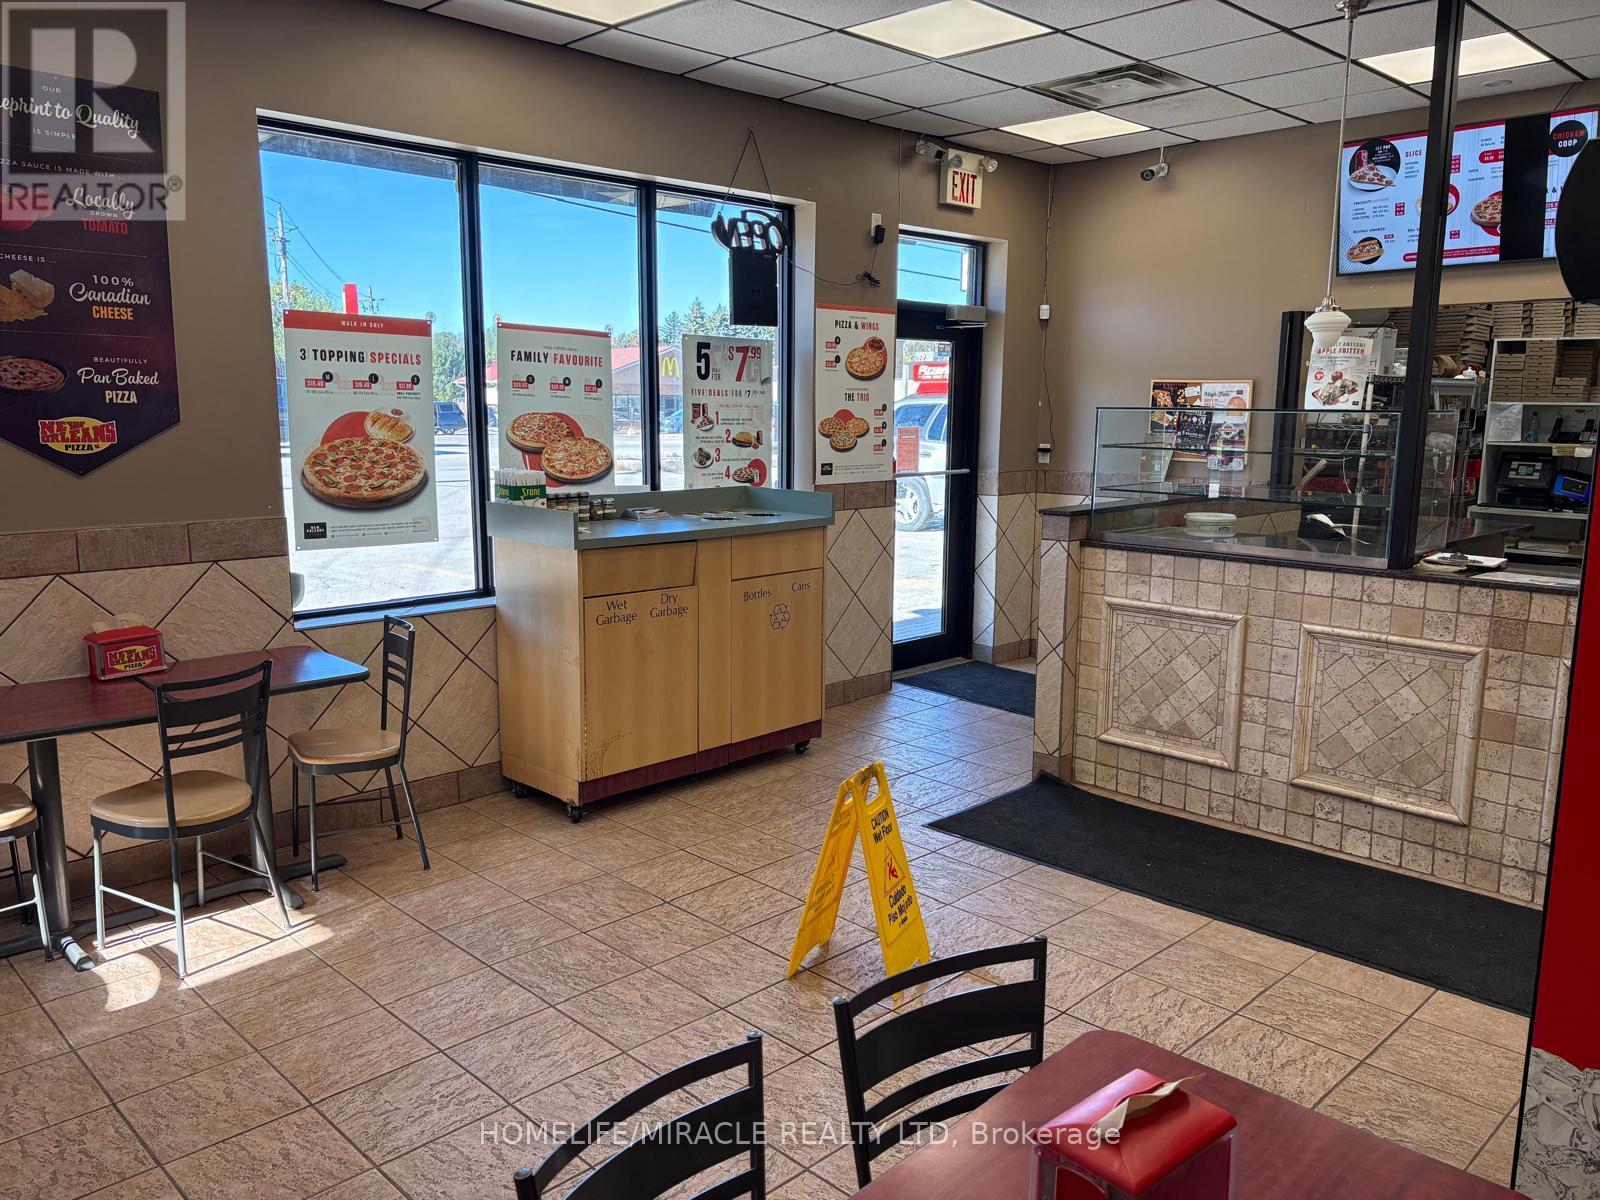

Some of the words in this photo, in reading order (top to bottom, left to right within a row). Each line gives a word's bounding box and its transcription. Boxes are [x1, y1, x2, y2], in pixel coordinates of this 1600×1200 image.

[42, 85, 61, 93] OUR
[0, 97, 52, 118] eprint
[55, 102, 73, 119] to
[75, 104, 140, 139] Quality
[45, 129, 77, 140] SIMPLE
[1553, 129, 1585, 140] CHICKEN
[1558, 139, 1577, 148] COOP
[21, 161, 51, 170] SAUCE
[66, 167, 91, 175] MADE
[952, 170, 977, 205] EXIT
[65, 187, 135, 220] Locally
[90, 210, 118, 218] GROWN
[82, 218, 129, 235] TOMATO
[92, 274, 134, 287] 100%
[69, 282, 151, 305] Canadian
[92, 305, 134, 320] CHEESE
[369, 321, 384, 329] ONLY
[834, 320, 851, 329] PIZZA
[854, 321, 858, 330] &
[861, 321, 879, 331] WINGS
[300, 348, 306, 361] 3
[312, 349, 365, 363] TOPPING
[370, 351, 422, 366] SPECIALS
[1339, 347, 1365, 355] FRITTER
[93, 356, 148, 365] BEAUTIFULLY
[510, 350, 549, 363] FAMILY
[553, 353, 603, 368] FAVOURITE
[697, 342, 711, 380] 5
[77, 367, 111, 385] Pan
[111, 368, 160, 386] Baked
[105, 390, 137, 404] PIZZA
[691, 388, 705, 396] FIVE
[709, 389, 728, 397] DEALS
[844, 392, 854, 402] THE
[857, 392, 870, 402] TRIO
[40, 421, 85, 433] NEW
[41, 423, 117, 443] ORLEANS
[725, 429, 731, 443] 2
[715, 448, 720, 462] 3
[725, 465, 730, 479] 4
[791, 581, 811, 593] Cans
[660, 592, 678, 605] Dry
[743, 588, 772, 602] Bottles
[606, 600, 628, 611] Wet
[650, 605, 689, 619] Garbage
[595, 612, 638, 626] Garbage
[871, 808, 889, 830] CAUTION
[873, 829, 883, 845] Wet
[881, 822, 893, 838] Floor
